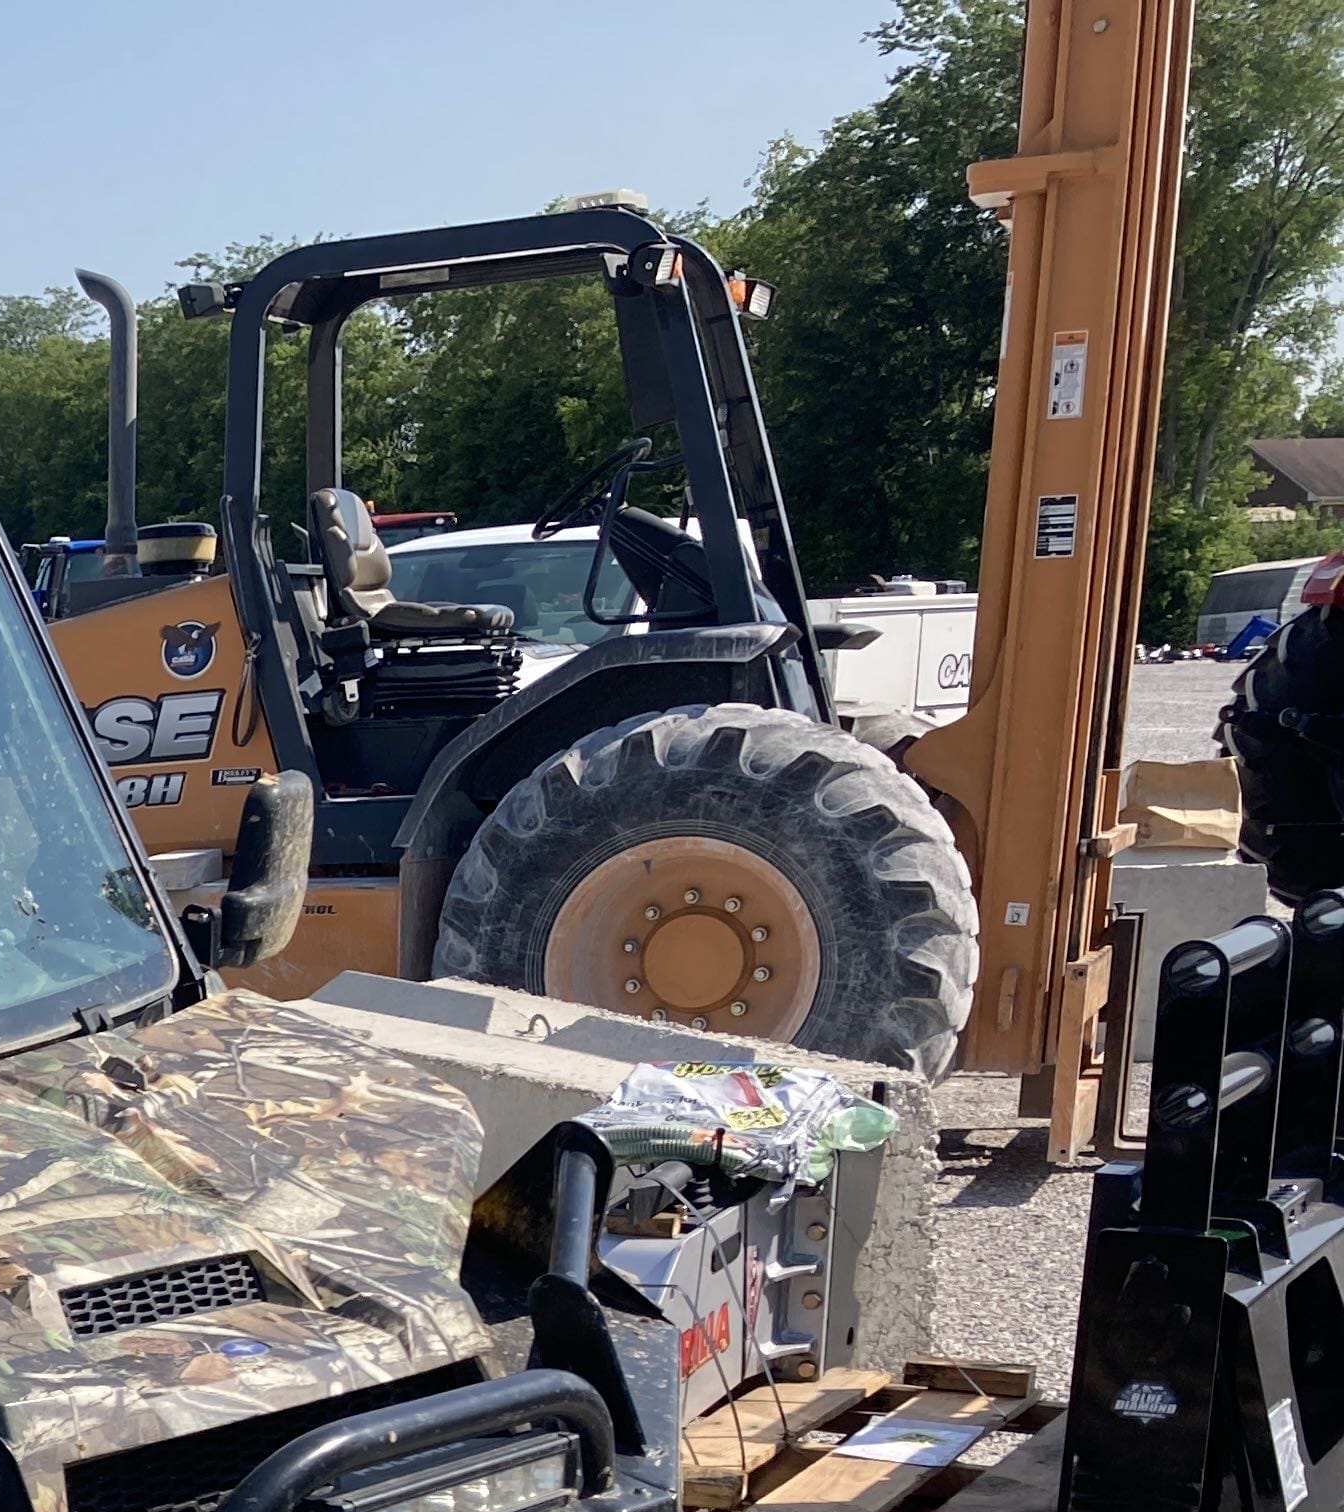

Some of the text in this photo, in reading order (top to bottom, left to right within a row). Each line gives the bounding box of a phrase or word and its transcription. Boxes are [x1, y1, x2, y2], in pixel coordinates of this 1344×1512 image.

[938, 653, 971, 689] CA
[94, 694, 221, 762] SE
[116, 774, 185, 807] 8H
[680, 1300, 731, 1384] RILLA
[1114, 1399, 1178, 1415] DIAMOND
[1131, 1392, 1163, 1402] BLUE
